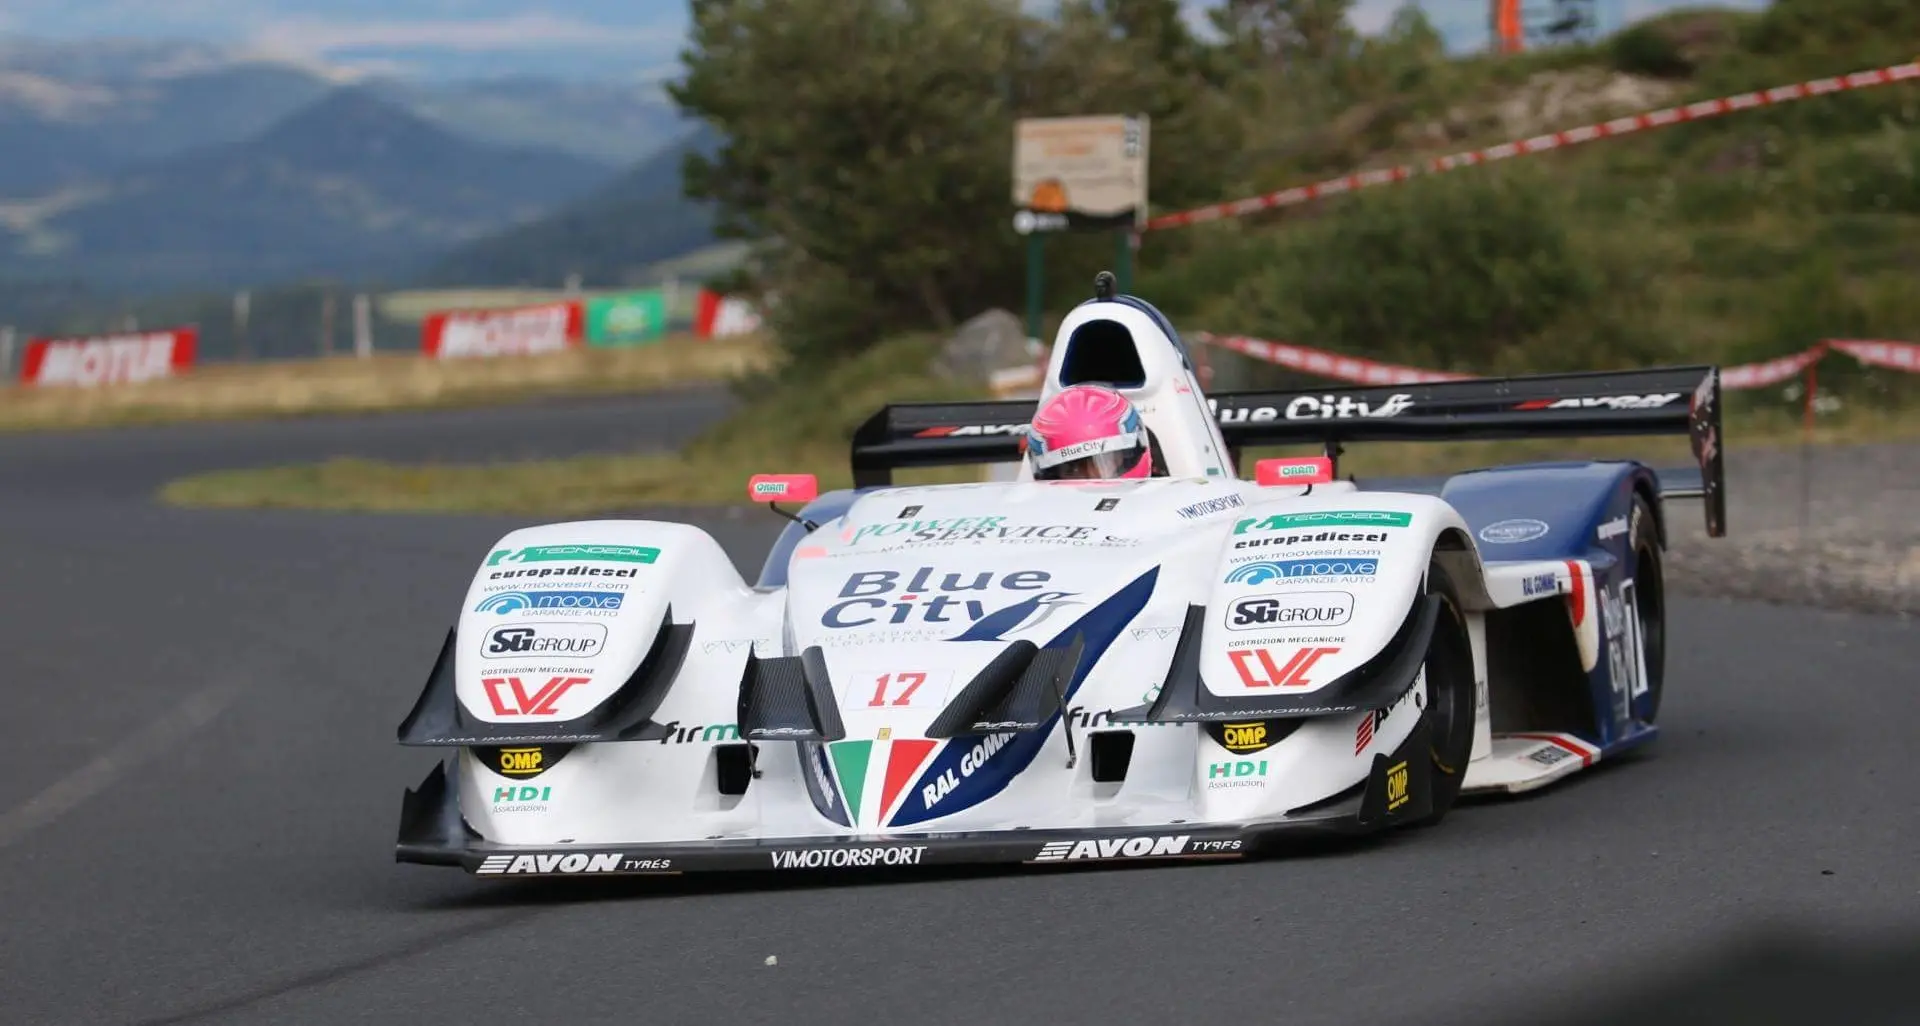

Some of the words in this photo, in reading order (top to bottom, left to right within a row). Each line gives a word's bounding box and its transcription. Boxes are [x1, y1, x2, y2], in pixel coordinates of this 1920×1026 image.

[1060, 441, 1081, 458] Blue
[849, 516, 1006, 547] POWER
[905, 526, 1099, 543] SERVICE
[1234, 532, 1388, 550] europadiesel
[1229, 548, 1382, 564] www.moovesrl.com
[489, 566, 638, 581] europadiesel
[1289, 562, 1375, 577] moove
[484, 581, 629, 593] www.moovesrl.com
[838, 567, 1052, 598] Blue
[1275, 577, 1339, 586] GARANZIE
[1343, 576, 1376, 584] AUTO
[536, 596, 621, 608] moove
[521, 609, 582, 617] GARANZIE
[583, 609, 619, 618] AUTO
[821, 594, 1050, 641] City
[1278, 607, 1344, 621] GROUP
[531, 638, 597, 652] GROUP
[1228, 638, 1285, 648] COSTRUZIONI
[481, 667, 536, 676] COSTRUZIONI
[538, 667, 595, 675] MECCANICHE
[868, 672, 928, 707] 17
[1224, 725, 1267, 746] OMP
[500, 751, 543, 771] OMP
[1209, 760, 1267, 779] HDI
[922, 769, 961, 810] RAL
[1387, 769, 1408, 801] OMP
[493, 786, 553, 803] HDI
[1066, 835, 1189, 860] AVON
[513, 853, 623, 873] AVON
[771, 846, 927, 869] VIMOTORSPORT
